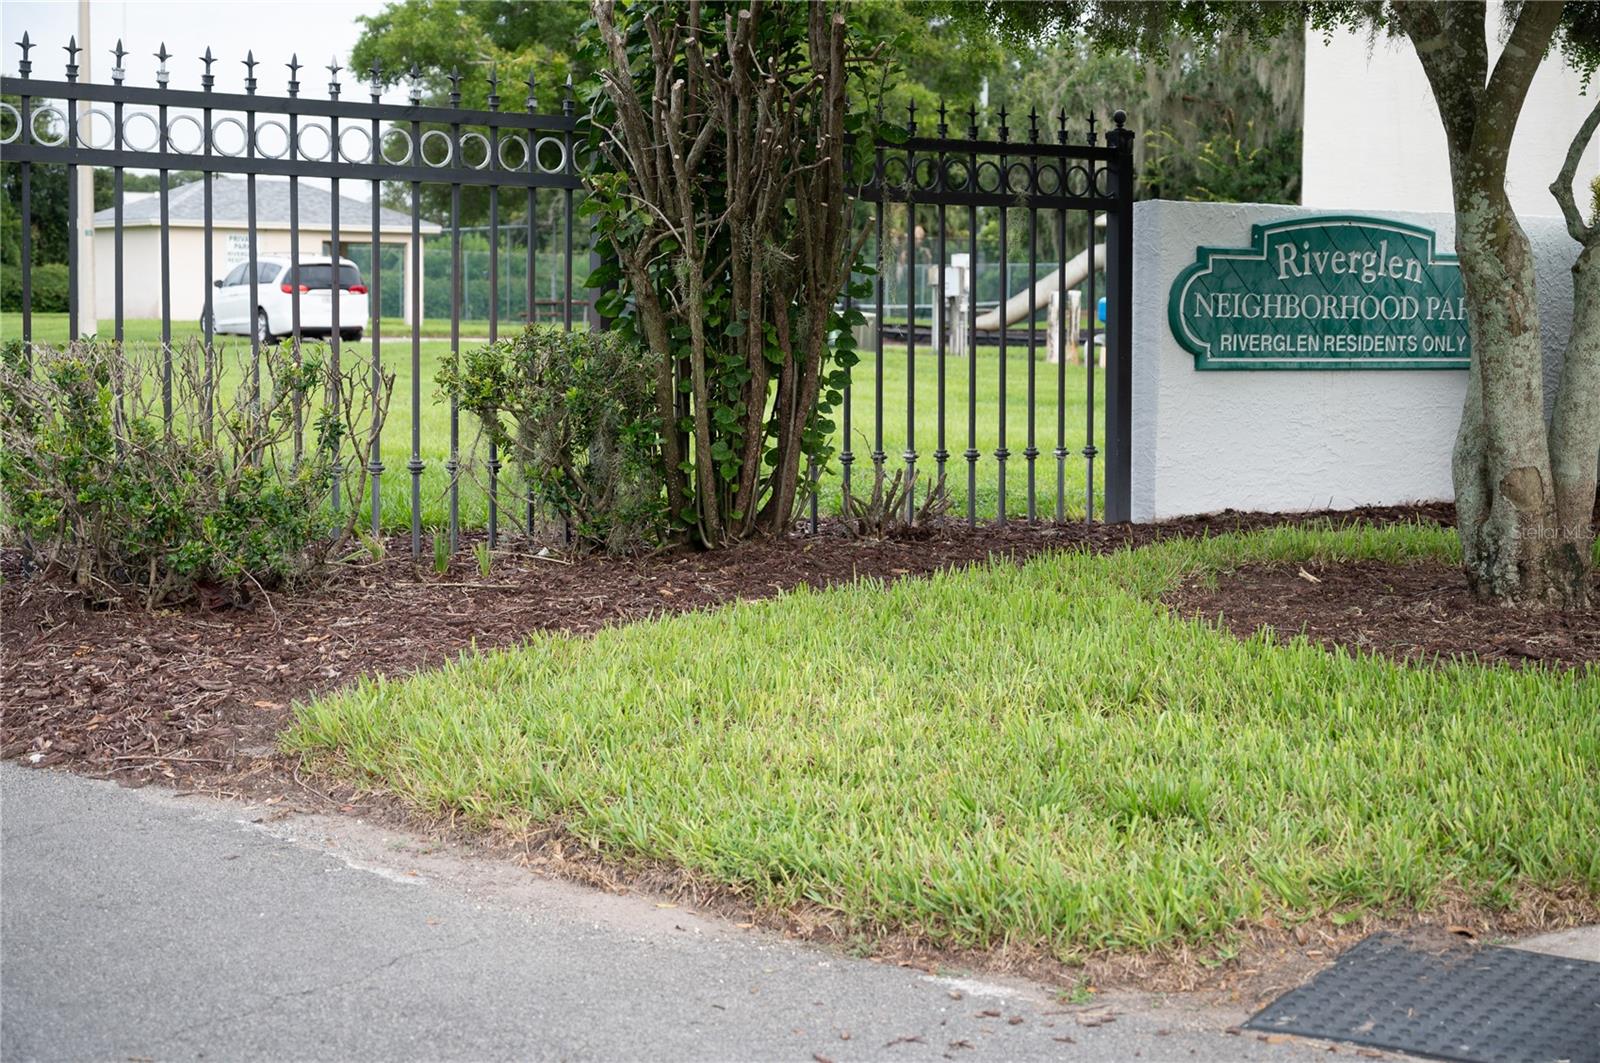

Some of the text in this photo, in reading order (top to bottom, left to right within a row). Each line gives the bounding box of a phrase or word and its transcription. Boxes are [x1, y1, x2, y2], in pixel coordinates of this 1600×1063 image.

[1275, 239, 1422, 283] Riverglen
[1194, 292, 1469, 320] NEIGHBORHOOD PAR
[1220, 334, 1467, 352] RIVERGLEN RESIDENTS ONLY
